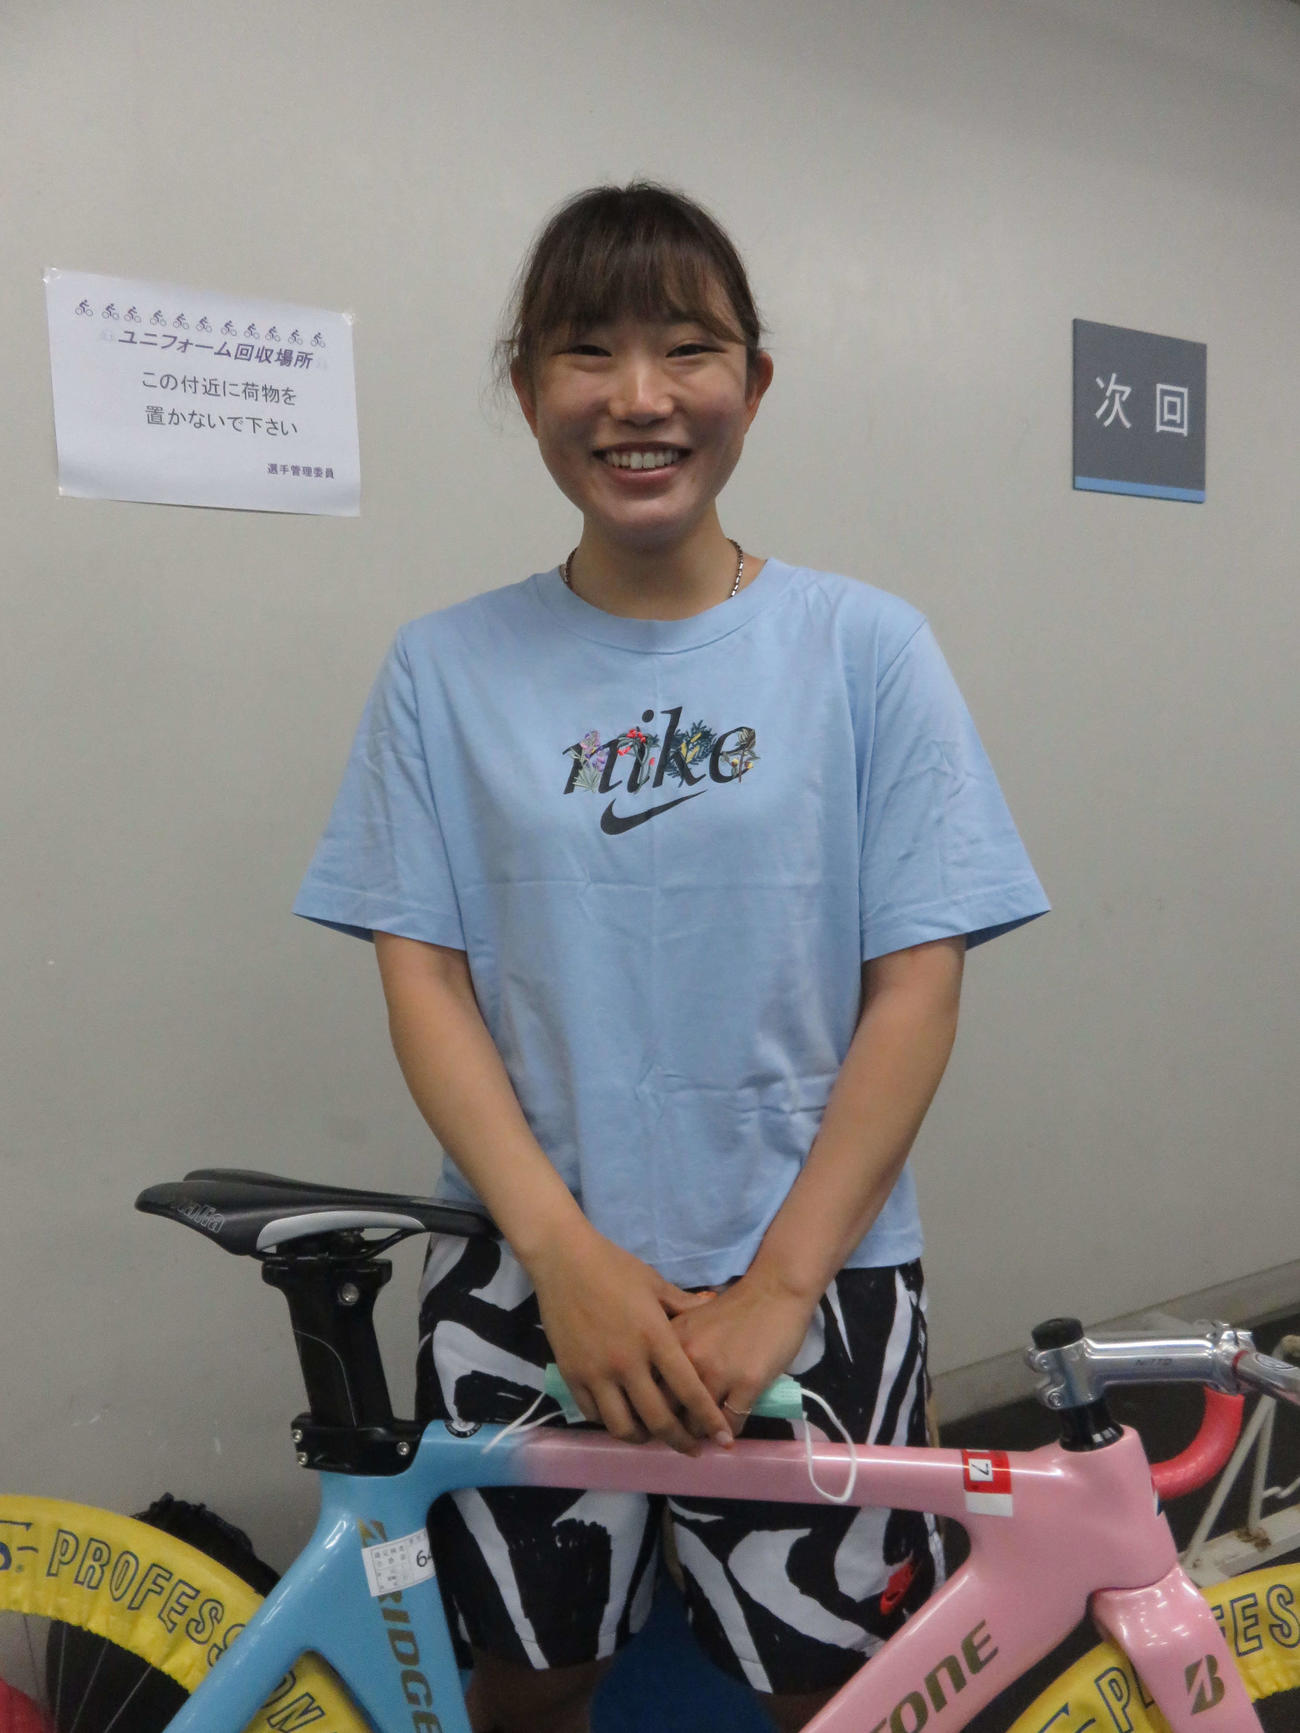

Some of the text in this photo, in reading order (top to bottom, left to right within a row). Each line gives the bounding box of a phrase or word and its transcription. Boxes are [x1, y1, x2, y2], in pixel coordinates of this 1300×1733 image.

[118, 329, 314, 370] ユニフォーム回収場所
[142, 371, 297, 406] この付近に荷物を
[1094, 372, 1189, 437] 次回
[145, 404, 298, 437] 置かないで下さい
[562, 706, 757, 795] nike
